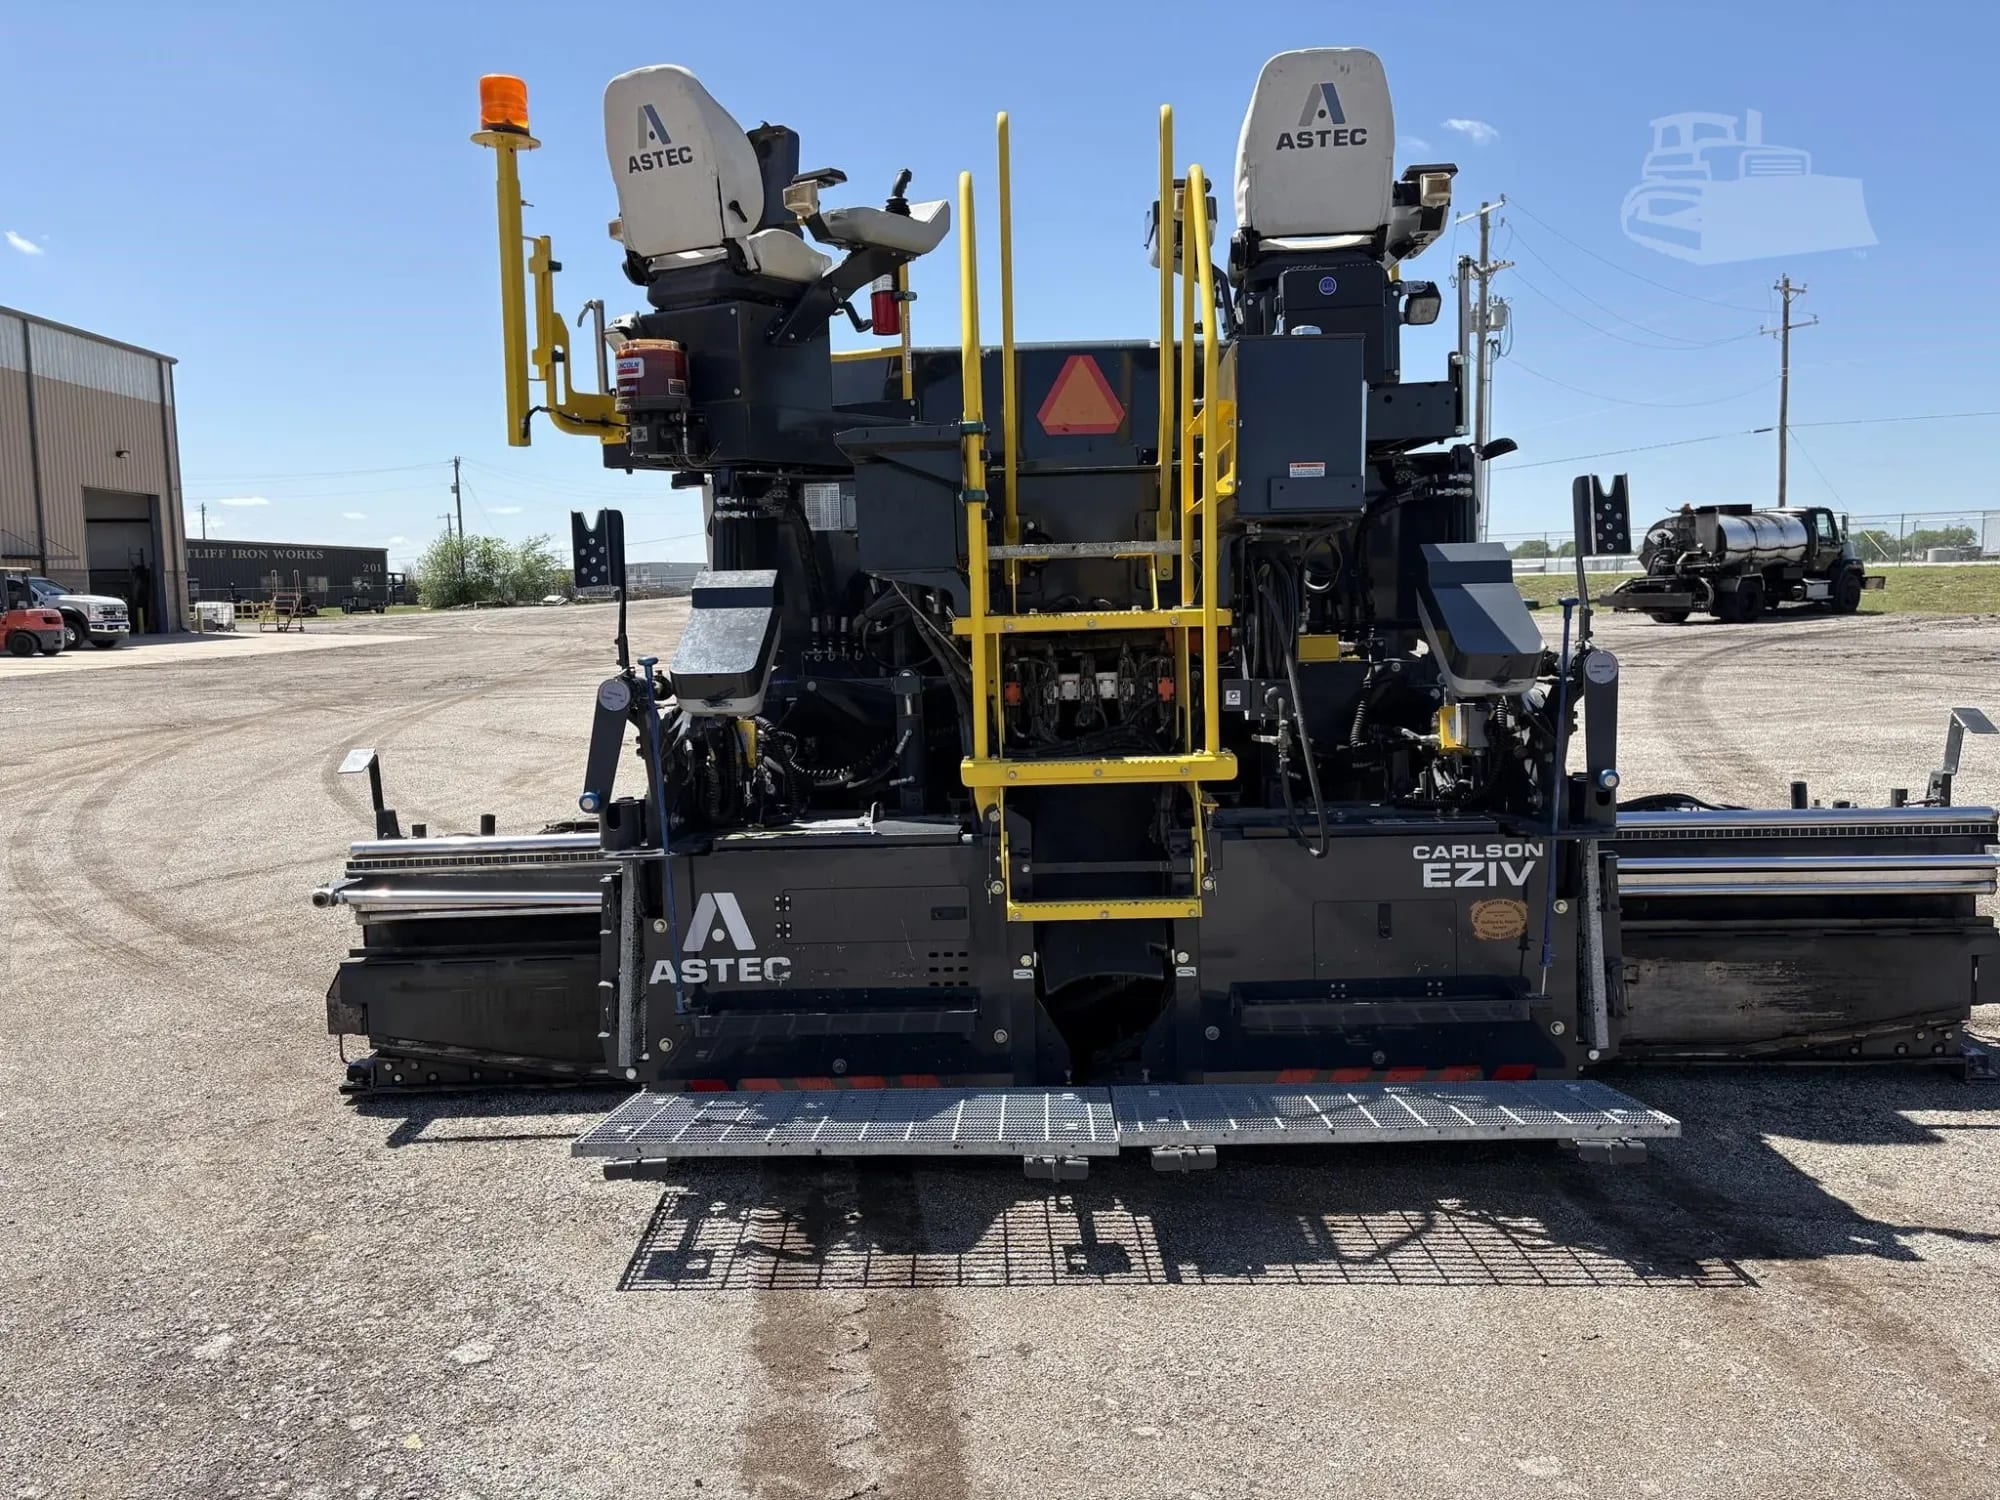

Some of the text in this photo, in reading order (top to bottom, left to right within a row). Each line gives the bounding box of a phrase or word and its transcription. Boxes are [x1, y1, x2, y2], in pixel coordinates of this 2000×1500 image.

[1276, 129, 1367, 150] ASTEC
[629, 146, 693, 173] ASTEC
[232, 549, 268, 559] IRON
[273, 549, 324, 560] WORKS
[362, 563, 381, 573] 201
[1413, 843, 1543, 859] CARLSON
[1423, 860, 1536, 888] EZIV
[648, 957, 792, 984] ASTEC
